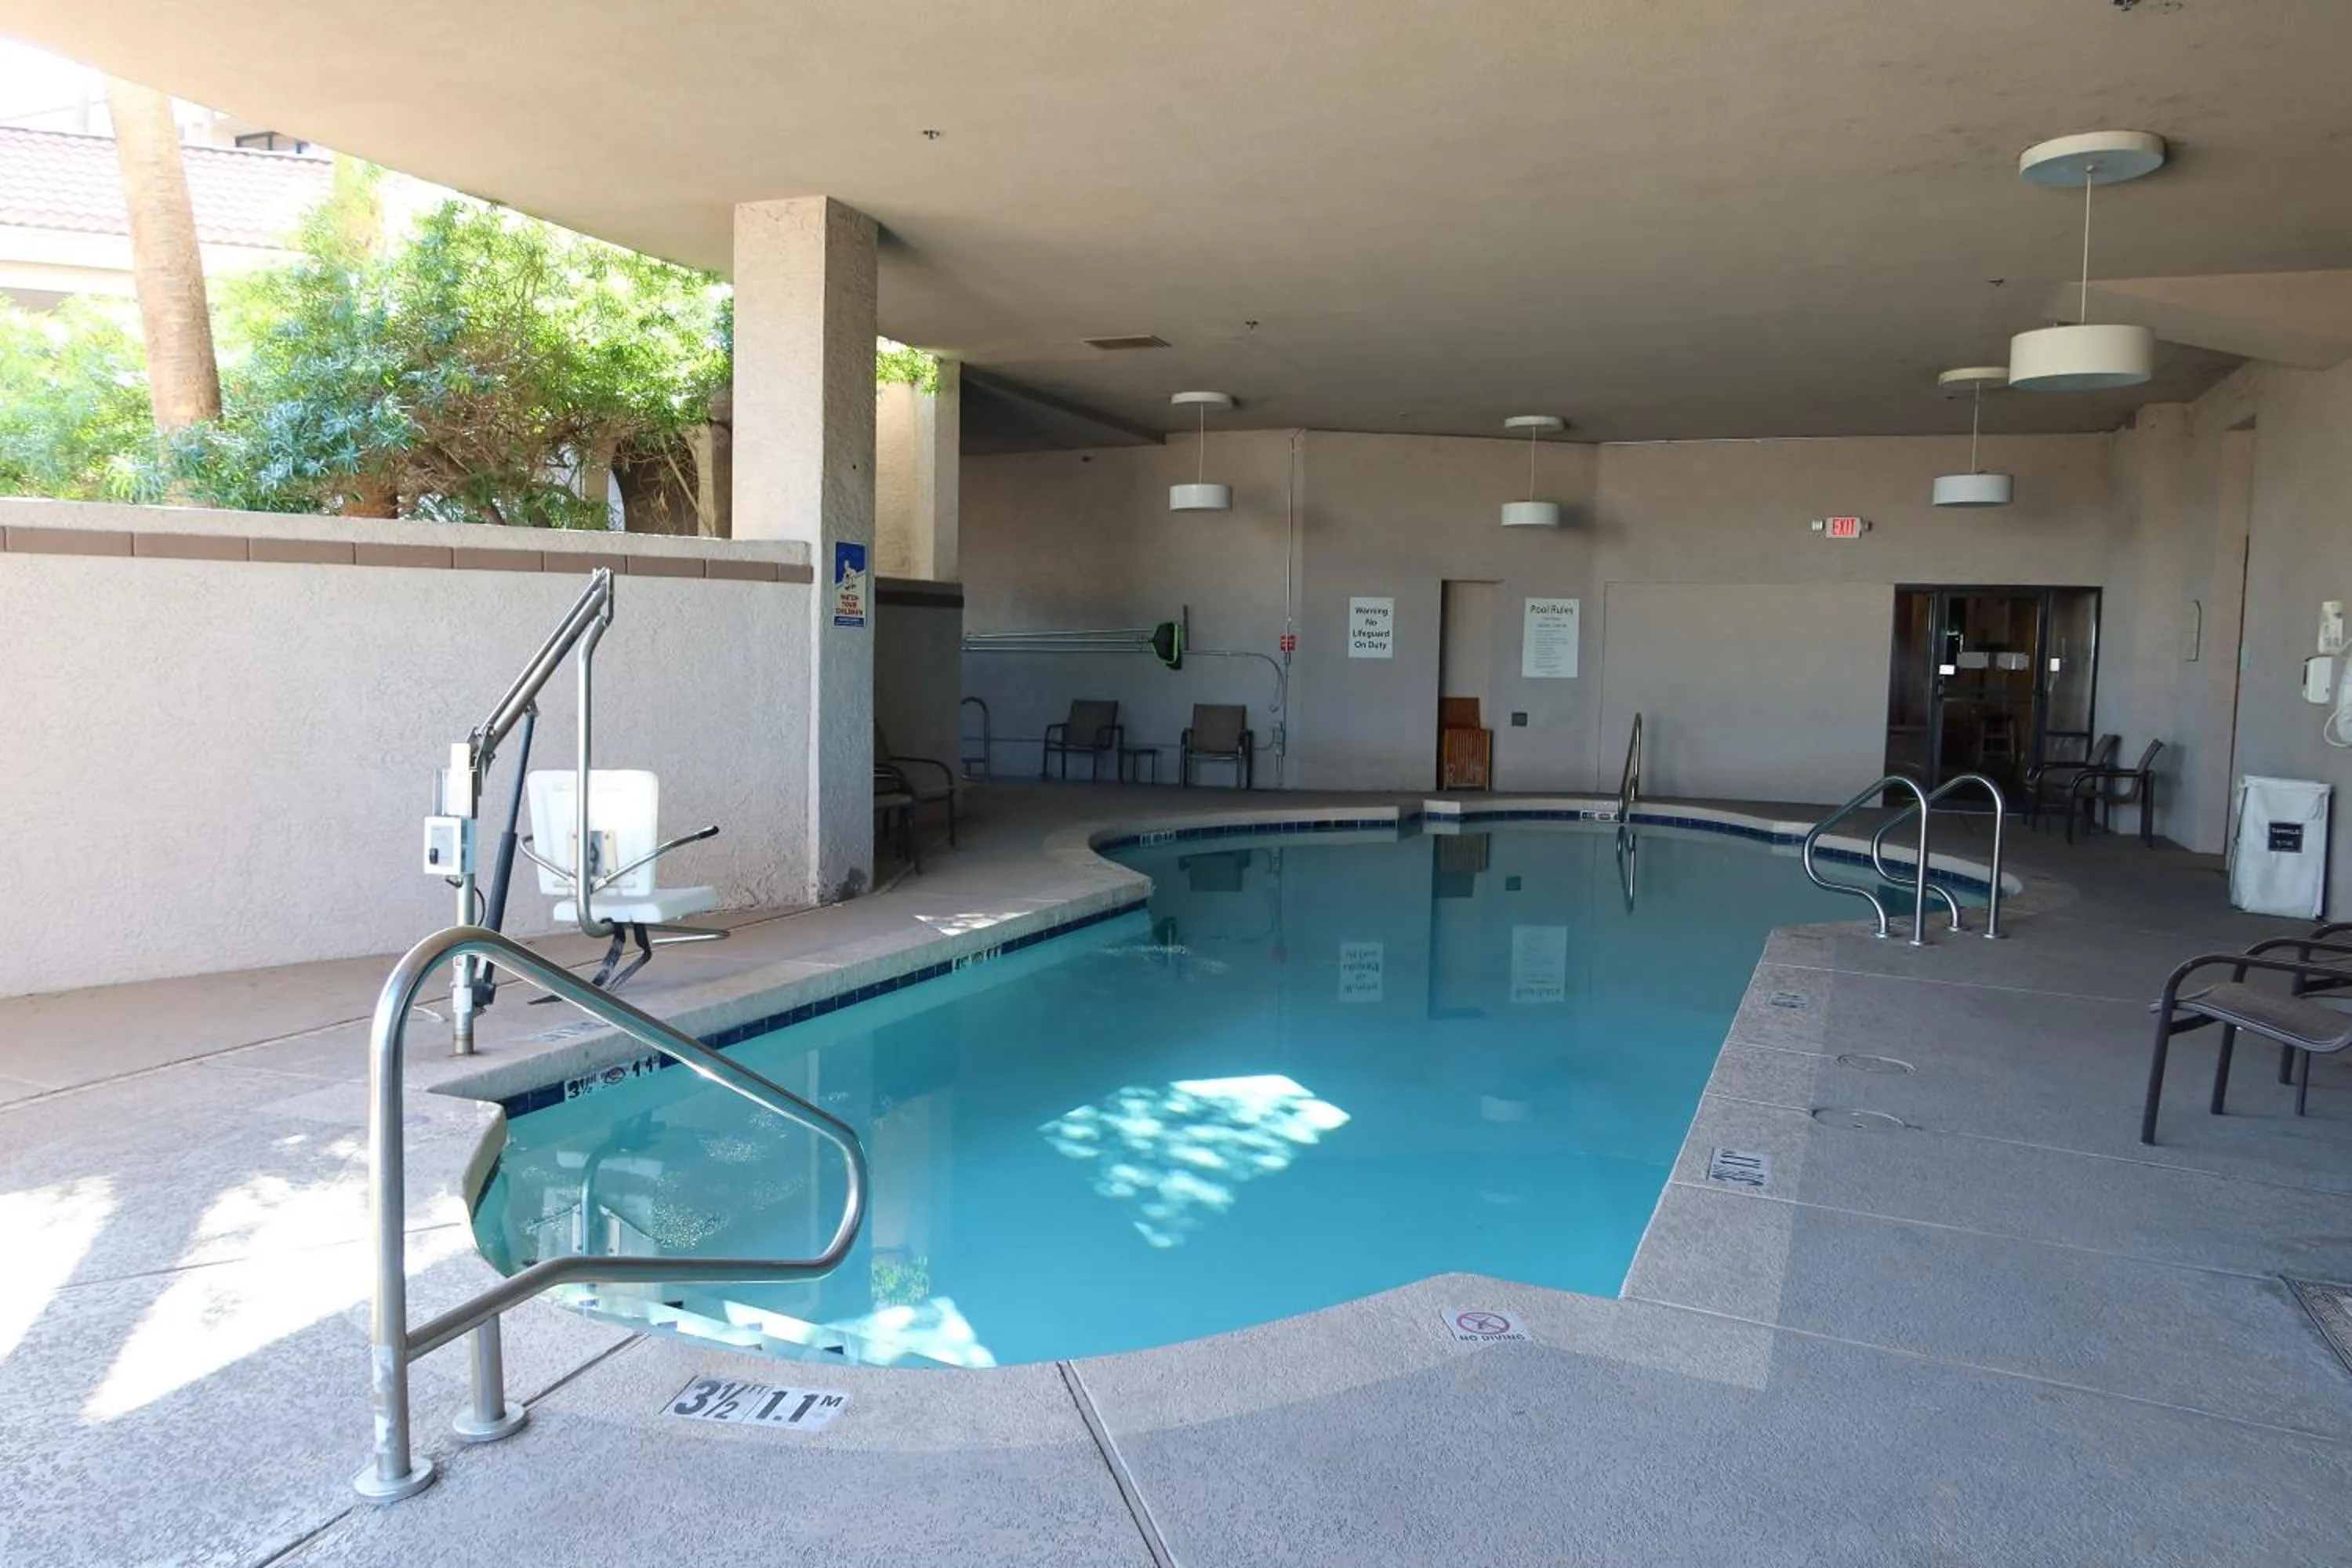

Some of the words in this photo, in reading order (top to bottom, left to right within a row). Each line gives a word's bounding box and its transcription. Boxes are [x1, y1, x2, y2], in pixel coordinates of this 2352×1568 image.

[1832, 518, 1857, 535] EXIT
[1355, 607, 1388, 617] Warning
[1366, 618, 1377, 626] No
[1352, 628, 1390, 638] Lifeguard
[1368, 641, 1386, 650] Duty
